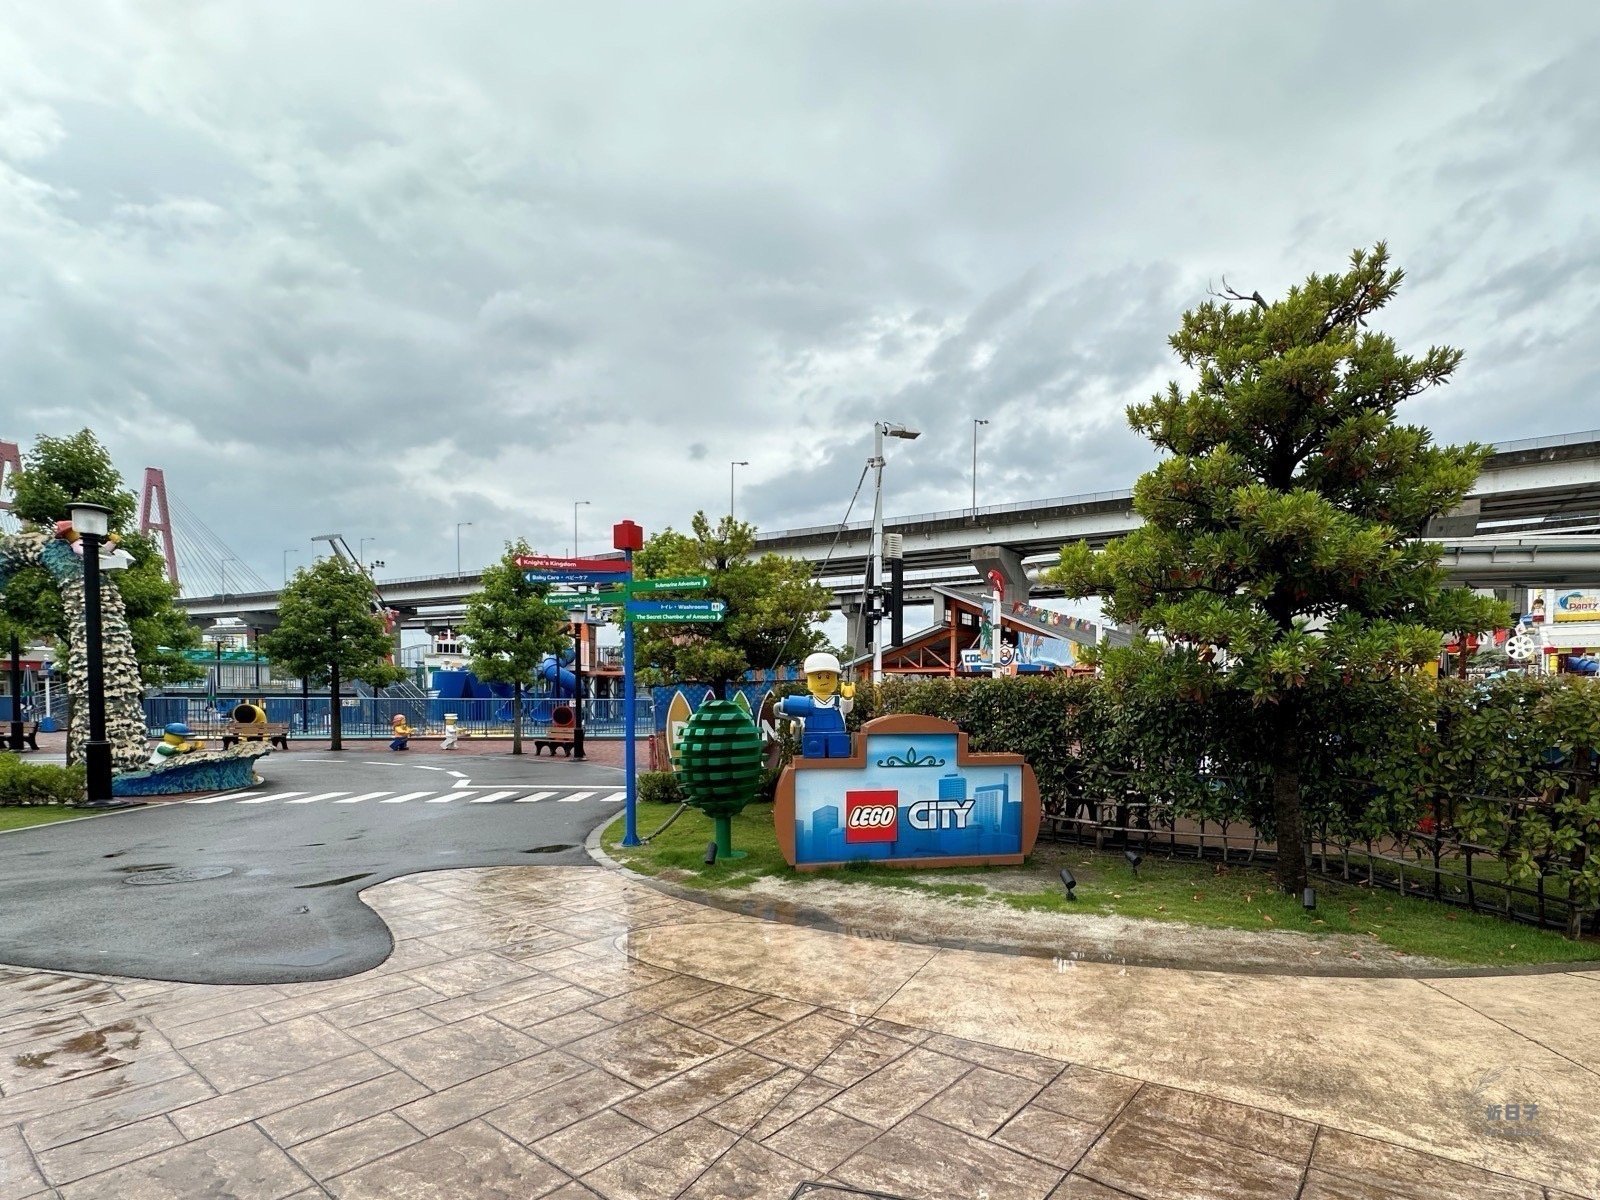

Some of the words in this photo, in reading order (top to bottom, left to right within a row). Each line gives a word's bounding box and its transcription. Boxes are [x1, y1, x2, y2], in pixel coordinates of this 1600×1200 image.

[523, 559, 549, 567] Knight's
[550, 560, 577, 568] Kingdom
[1569, 602, 1599, 610] PARTY
[848, 805, 896, 828] LEGO
[907, 799, 976, 830] CITY
